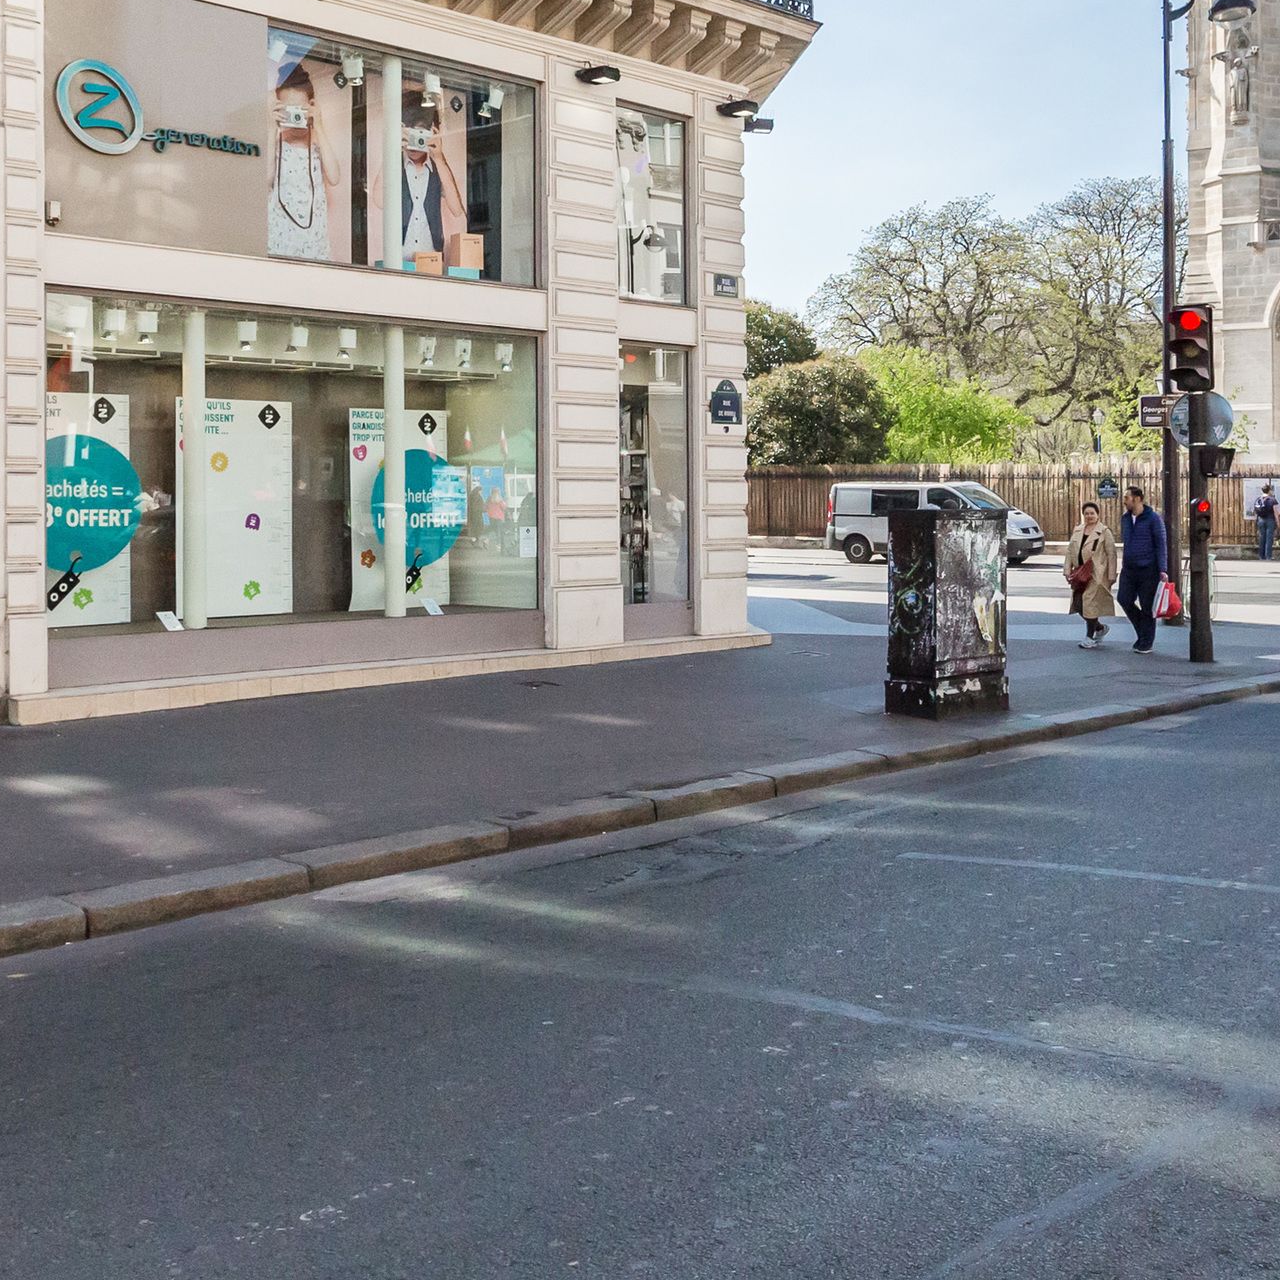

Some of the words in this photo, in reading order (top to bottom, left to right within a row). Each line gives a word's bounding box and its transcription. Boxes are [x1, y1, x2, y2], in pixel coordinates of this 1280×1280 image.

[206, 401, 231, 410] QU'ILS
[352, 410, 373, 419] PARCE
[352, 433, 370, 441] TROP
[46, 479, 108, 498] achetés
[66, 508, 133, 528] OFFERT
[410, 512, 458, 529] OFFERT
